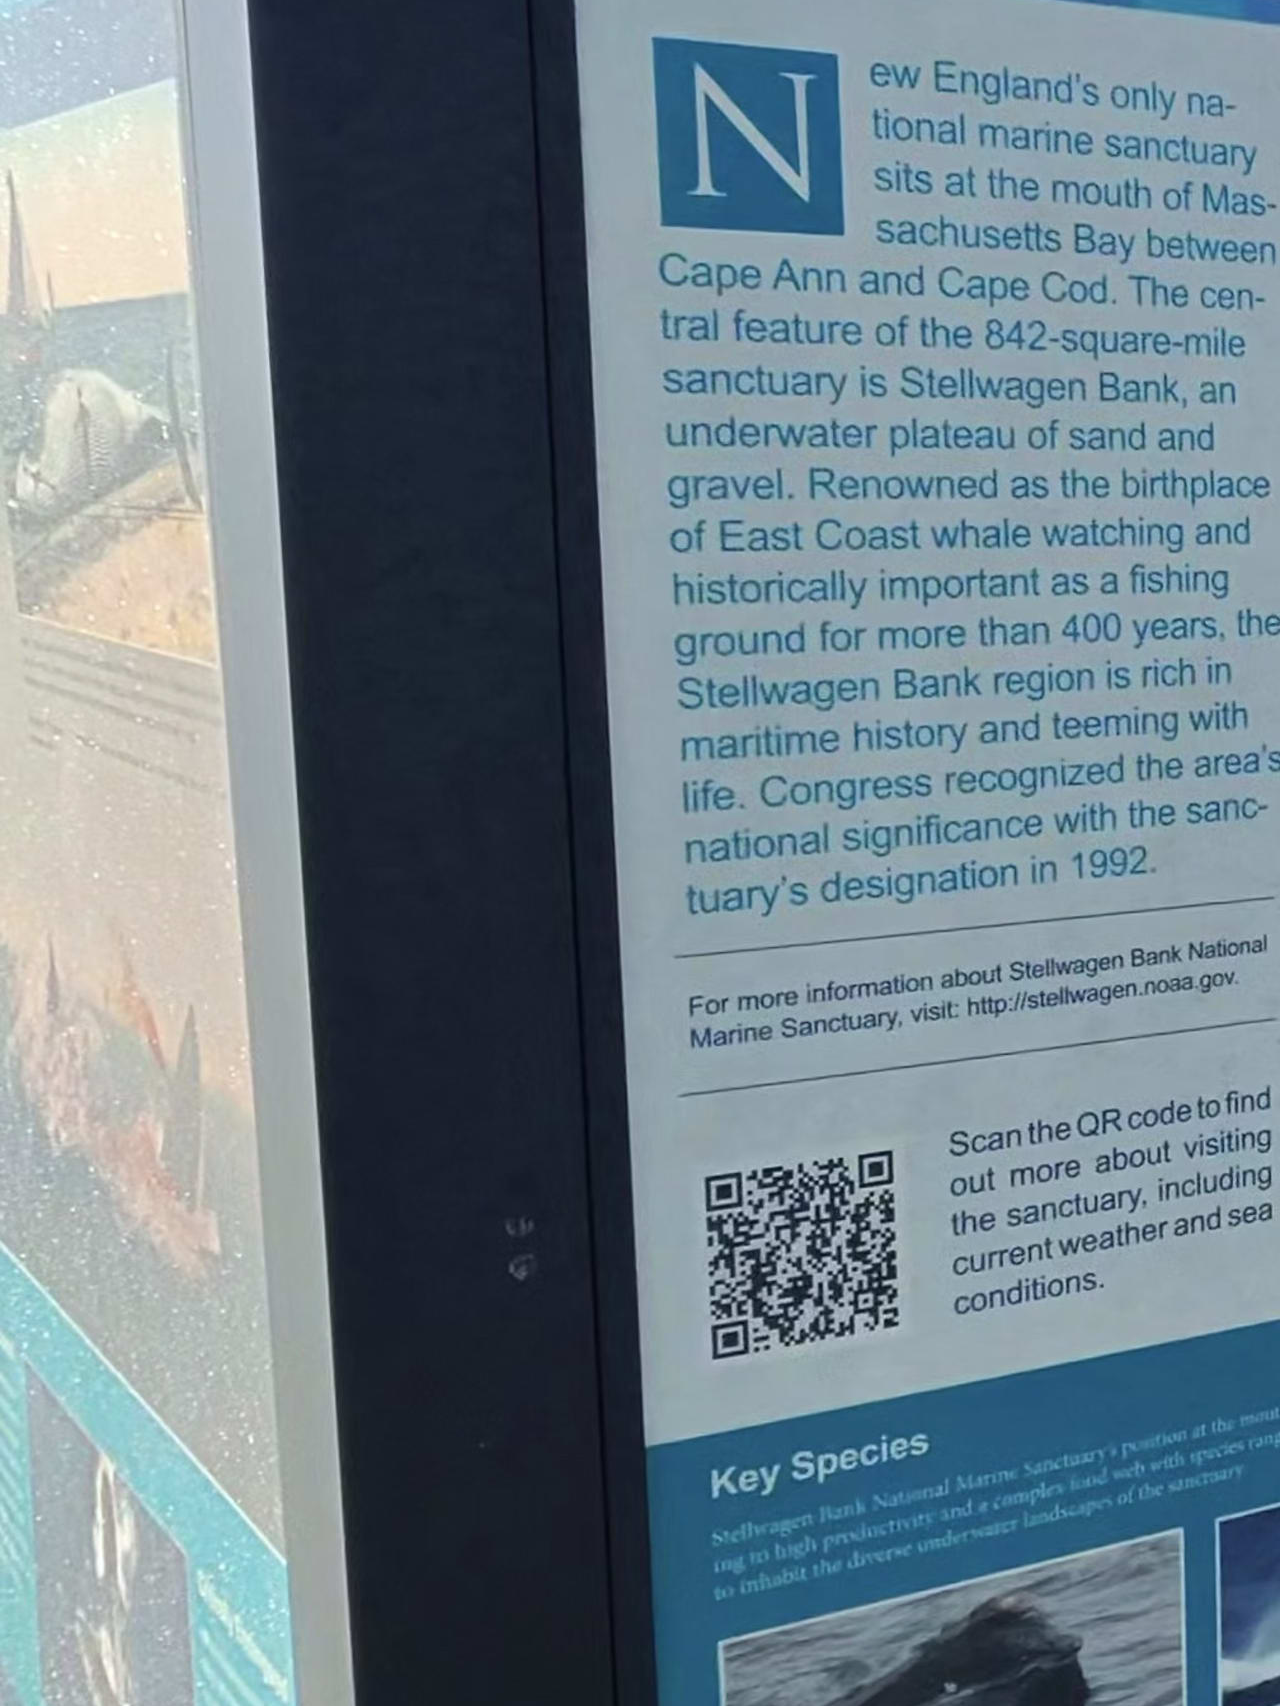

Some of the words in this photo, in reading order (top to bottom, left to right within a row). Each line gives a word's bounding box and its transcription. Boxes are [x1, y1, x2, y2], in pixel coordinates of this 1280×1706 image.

[870, 63, 921, 89] ew
[934, 60, 1099, 106] England's
[1111, 82, 1176, 120] only
[1188, 93, 1236, 117] na-
[873, 108, 965, 144] tional
[979, 122, 1093, 155] marine
[1105, 135, 1257, 175] sanctuary
[875, 161, 933, 194] sits
[945, 167, 976, 197] at
[988, 168, 1039, 201] the
[1052, 178, 1151, 208] mouth
[1163, 181, 1193, 210] of
[1203, 183, 1277, 216] Mas-
[877, 215, 1062, 252] sachusetts
[1074, 223, 1135, 264] Bay
[1147, 228, 1276, 264] between
[659, 253, 761, 296] Cape
[773, 259, 846, 292] Ann
[860, 265, 924, 296] and
[938, 266, 1030, 307] Cape
[1042, 271, 1116, 304] Cod.
[1128, 275, 1188, 308] The
[1200, 287, 1265, 310] cen-
[661, 309, 718, 341] tral
[733, 309, 862, 345] feature
[875, 315, 909, 346] of
[920, 317, 972, 349] the
[985, 319, 1245, 360] 842-square-mile
[663, 366, 847, 405] sanctuary
[860, 366, 887, 397] is
[900, 366, 1086, 409] Stellwagen
[1099, 372, 1187, 408] Bank,
[1200, 382, 1236, 404] an
[666, 417, 878, 448] underwater
[890, 418, 1015, 457] plateau
[1028, 419, 1059, 449] of
[1069, 422, 1146, 451] sand
[1158, 422, 1214, 451] and
[668, 468, 794, 509] gravel.
[809, 467, 998, 500] Renowned
[1011, 476, 1049, 499] as
[1060, 468, 1110, 498] the
[1122, 468, 1270, 506] birthplace
[670, 520, 706, 553] of
[720, 520, 803, 552] East
[816, 519, 921, 550] Coast
[931, 518, 1031, 548] whale
[1042, 517, 1183, 553] watching
[1195, 516, 1250, 545] and
[673, 570, 867, 610] historically
[880, 568, 1040, 607] important
[1051, 573, 1089, 596] as
[1100, 572, 1118, 594] a
[1130, 564, 1229, 599] fishing
[674, 623, 805, 666] ground
[820, 621, 867, 652] for
[879, 625, 966, 649] more
[979, 616, 1050, 646] than
[1062, 613, 1121, 643] 400
[1133, 617, 1224, 649] years,
[1237, 608, 1280, 637] the
[678, 675, 879, 711] Stellwagen
[894, 666, 981, 699] Bank
[994, 663, 1094, 701] region
[1106, 660, 1131, 689] is
[1142, 658, 1196, 688] rich
[1207, 656, 1231, 684] in
[681, 726, 839, 761] maritime
[854, 720, 967, 754] history
[979, 712, 1040, 744] and
[1053, 707, 1178, 741] teeming
[1189, 701, 1248, 731] with
[683, 779, 744, 813] life.
[760, 774, 932, 810] Congress
[945, 754, 1124, 798] recognized
[1136, 753, 1183, 781] the
[685, 823, 829, 863] national
[843, 814, 1043, 857] significance
[1054, 802, 1116, 834] with
[1129, 800, 1175, 828] the
[1187, 798, 1268, 824] sanc-
[686, 876, 808, 917] tuary's
[820, 860, 1018, 904] designation
[1031, 856, 1057, 884] in
[1072, 845, 1156, 879] 1992.
[689, 995, 729, 1017] For
[738, 991, 799, 1011] more
[807, 974, 933, 1003] information
[941, 965, 1002, 989] about
[1010, 955, 1124, 981] Stellwagen
[1131, 945, 1182, 967] Bank
[1189, 935, 1267, 960] National
[690, 1024, 773, 1048] Marine
[781, 1011, 902, 1038] Sanctuary,
[910, 1001, 959, 1022] visit:
[950, 1129, 1021, 1156] Scan
[1028, 1120, 1071, 1145] the
[1077, 1109, 1122, 1137] QR
[1128, 1100, 1192, 1130] code
[1197, 1097, 1220, 1119] to
[1225, 1086, 1270, 1114] find
[950, 1168, 995, 1196] out
[1010, 1160, 1080, 1187] more
[1096, 1141, 1171, 1173] about
[1184, 1130, 1271, 1158] visiting
[951, 1210, 996, 1236] the
[1007, 1188, 1147, 1227] sanctuary,
[1159, 1166, 1272, 1201] including
[953, 1237, 1053, 1275] current
[1059, 1221, 1168, 1256] weather
[1174, 1206, 1221, 1236] and
[1228, 1203, 1272, 1227] sea
[954, 1273, 1104, 1314] conditions.
[712, 1464, 780, 1498] Key
[792, 1434, 929, 1483] Species
[872, 1479, 950, 1512] National
